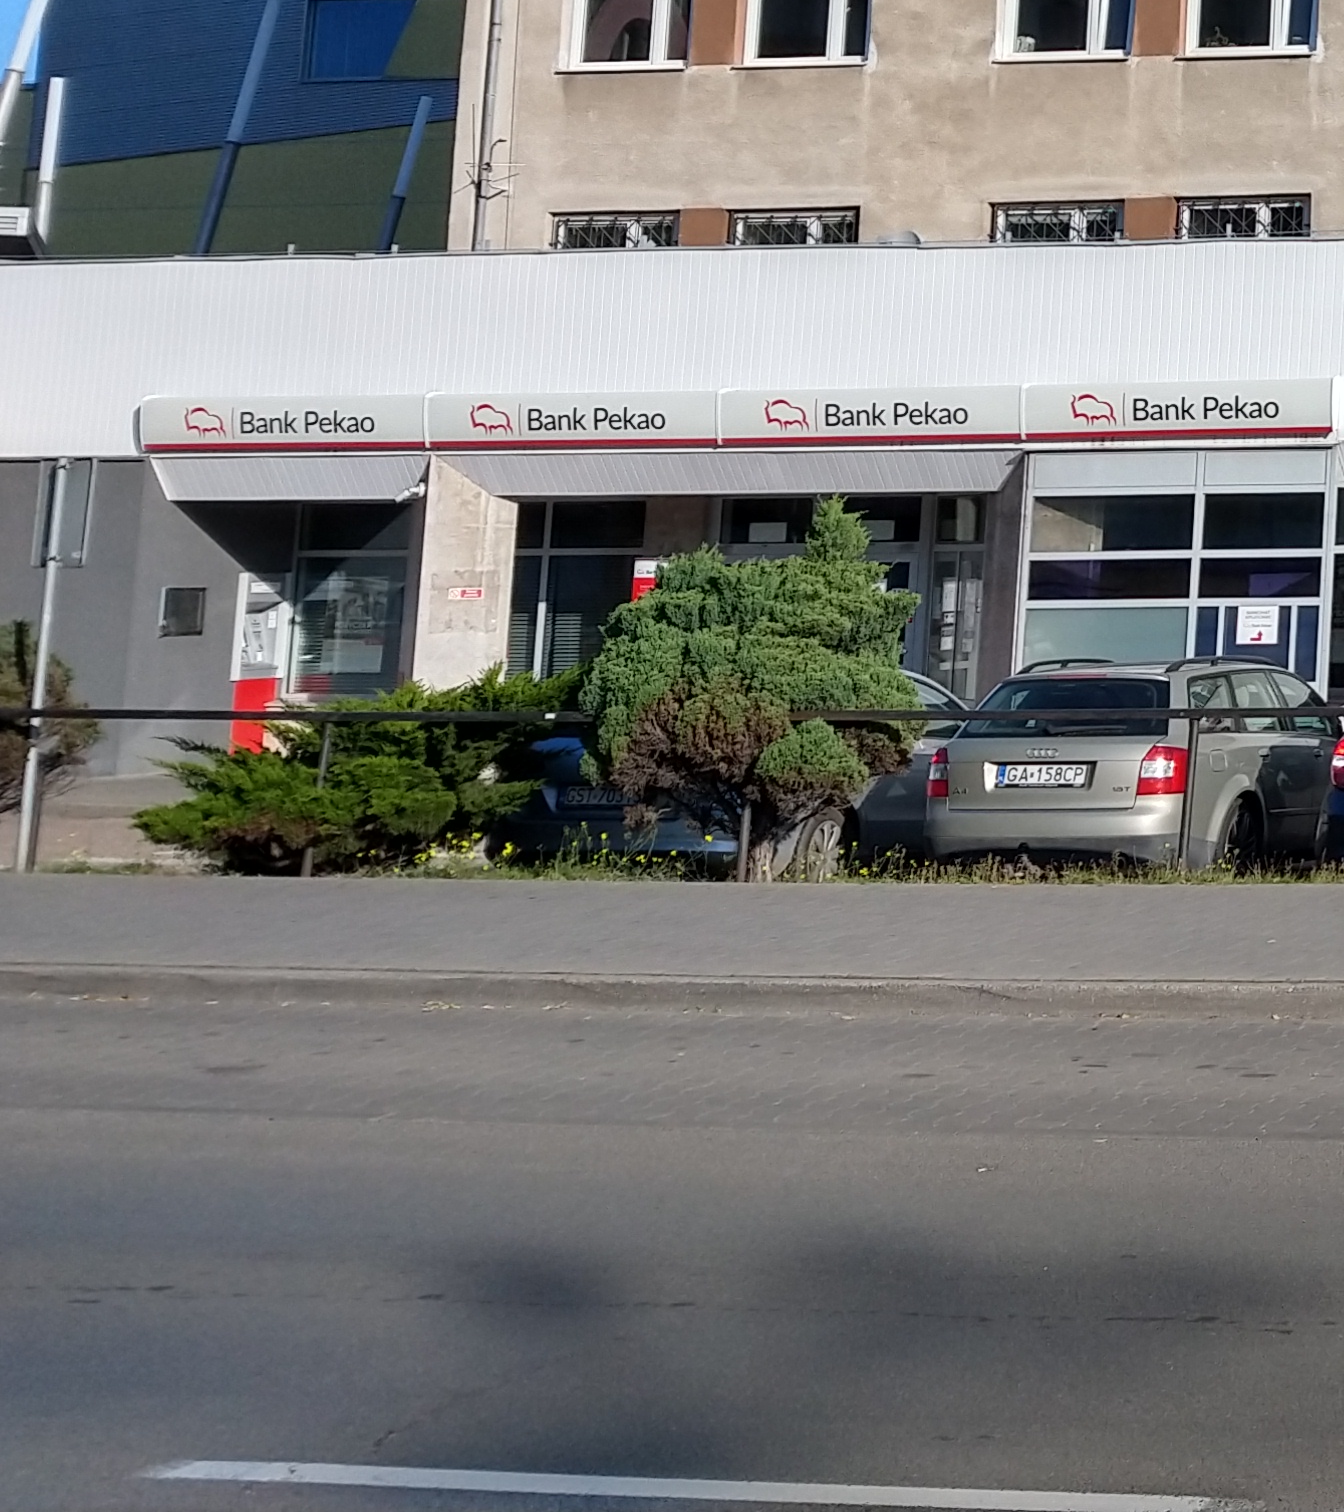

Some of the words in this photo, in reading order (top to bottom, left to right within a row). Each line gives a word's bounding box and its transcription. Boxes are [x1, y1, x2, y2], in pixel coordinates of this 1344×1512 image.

[527, 407, 587, 431] Bank
[593, 406, 666, 430] Pekao
[825, 402, 886, 427] Bank
[893, 401, 969, 425] Pekao
[1132, 396, 1196, 421] Bank
[1203, 395, 1280, 420] Pekao
[240, 410, 298, 434] Bank
[304, 410, 375, 434] Pekao
[1007, 767, 1028, 782] GA
[1036, 766, 1084, 782] 158CP
[566, 788, 593, 803] GST
